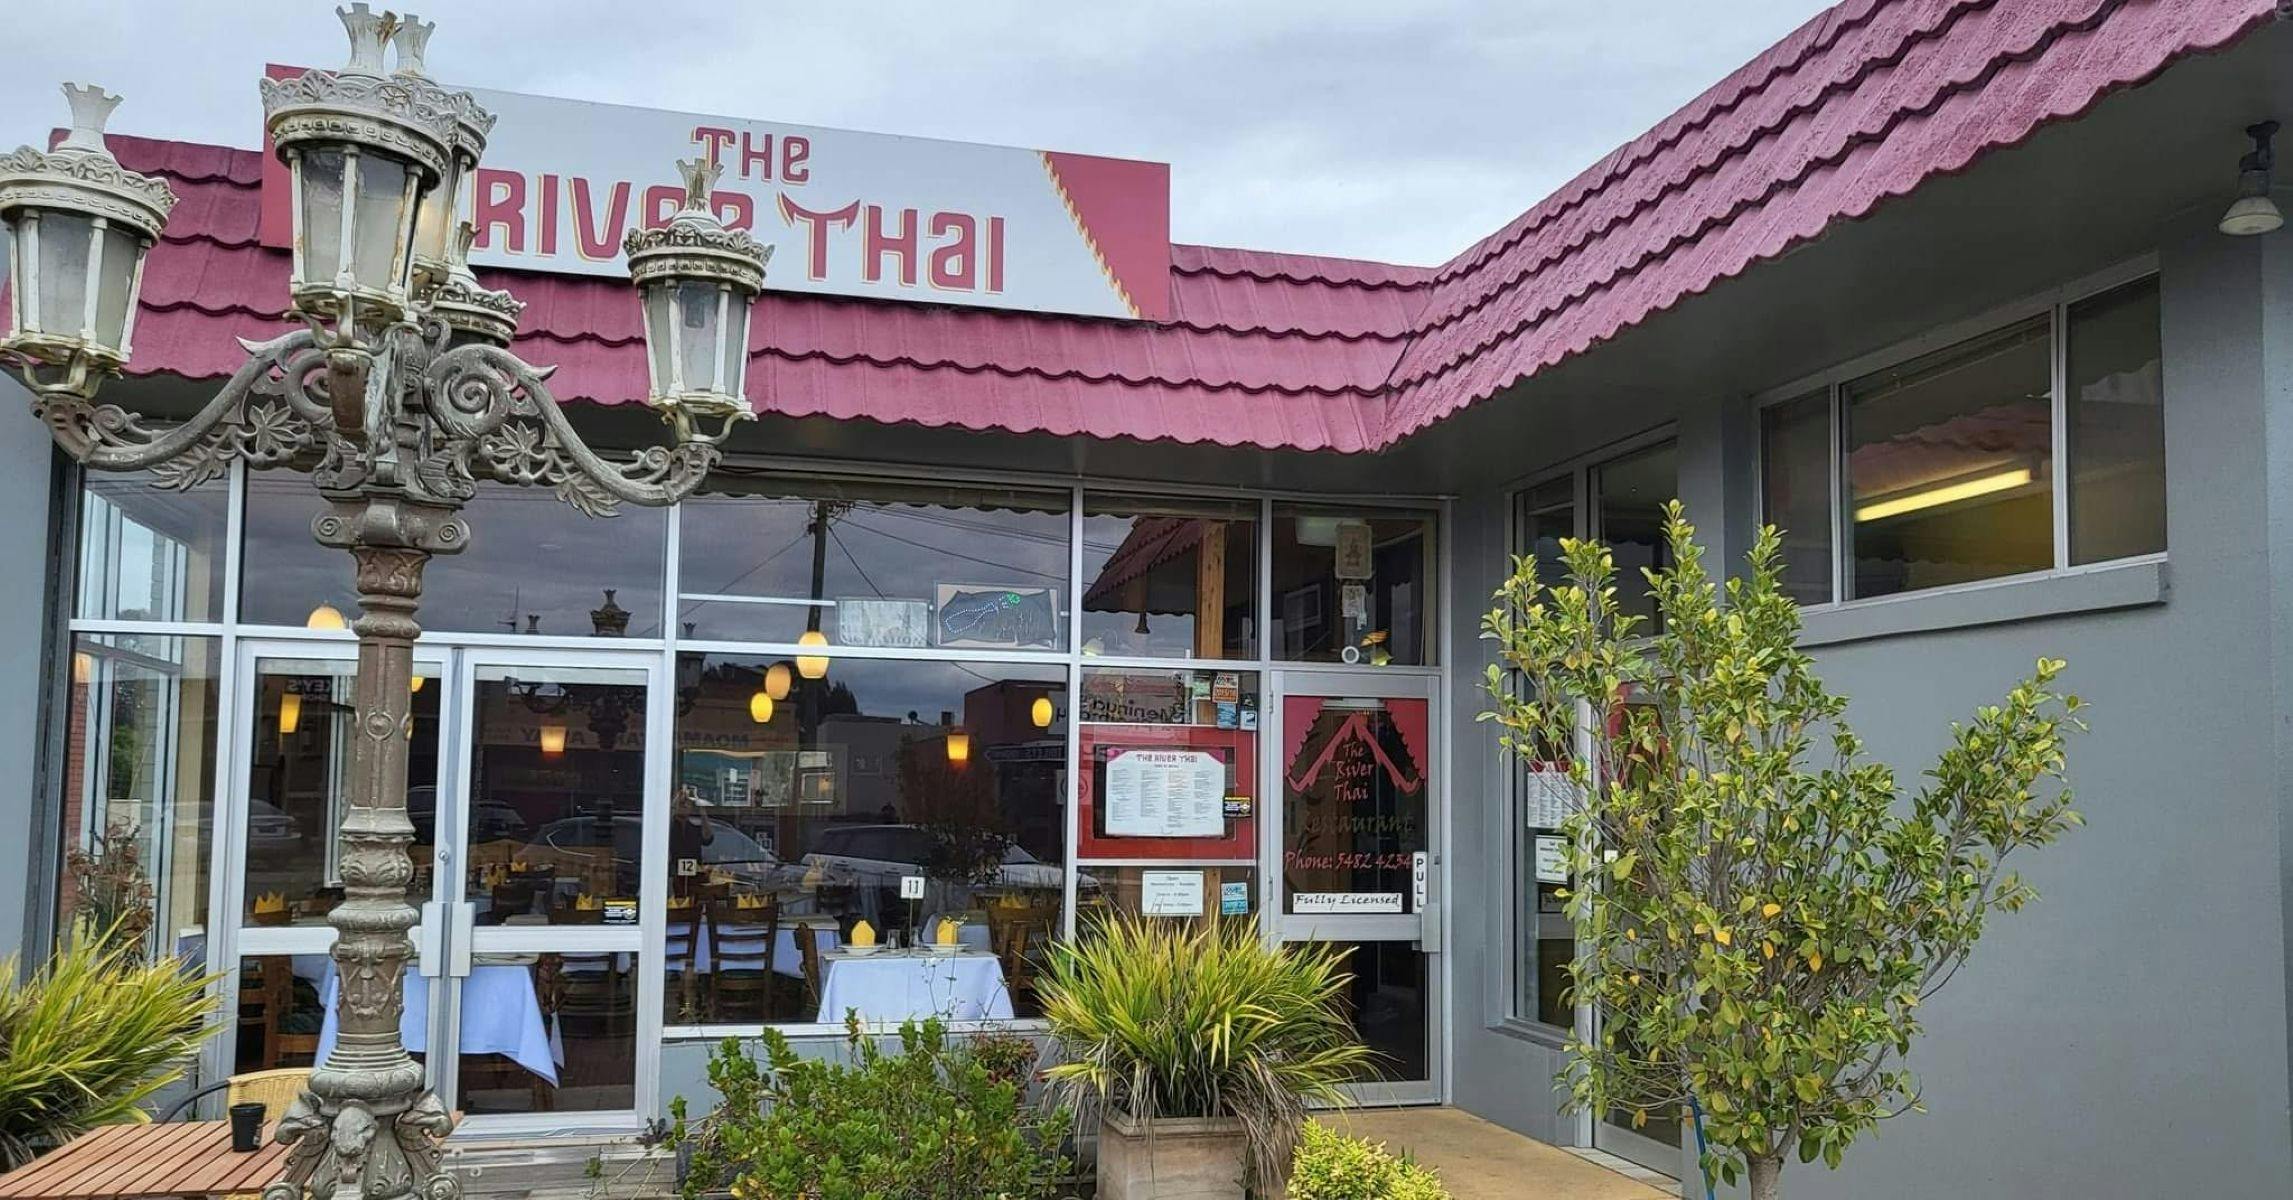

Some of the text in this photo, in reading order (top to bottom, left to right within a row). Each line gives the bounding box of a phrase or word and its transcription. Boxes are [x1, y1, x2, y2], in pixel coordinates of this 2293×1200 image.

[1342, 741, 1365, 758] The
[1334, 760, 1375, 780] River
[1334, 781, 1369, 801] Thai
[681, 860, 694, 872] 12
[1284, 850, 1333, 873] Phone:
[1336, 852, 1373, 870] 5482
[1416, 858, 1425, 908] PULL
[1294, 894, 1400, 911] Fully Licensed
